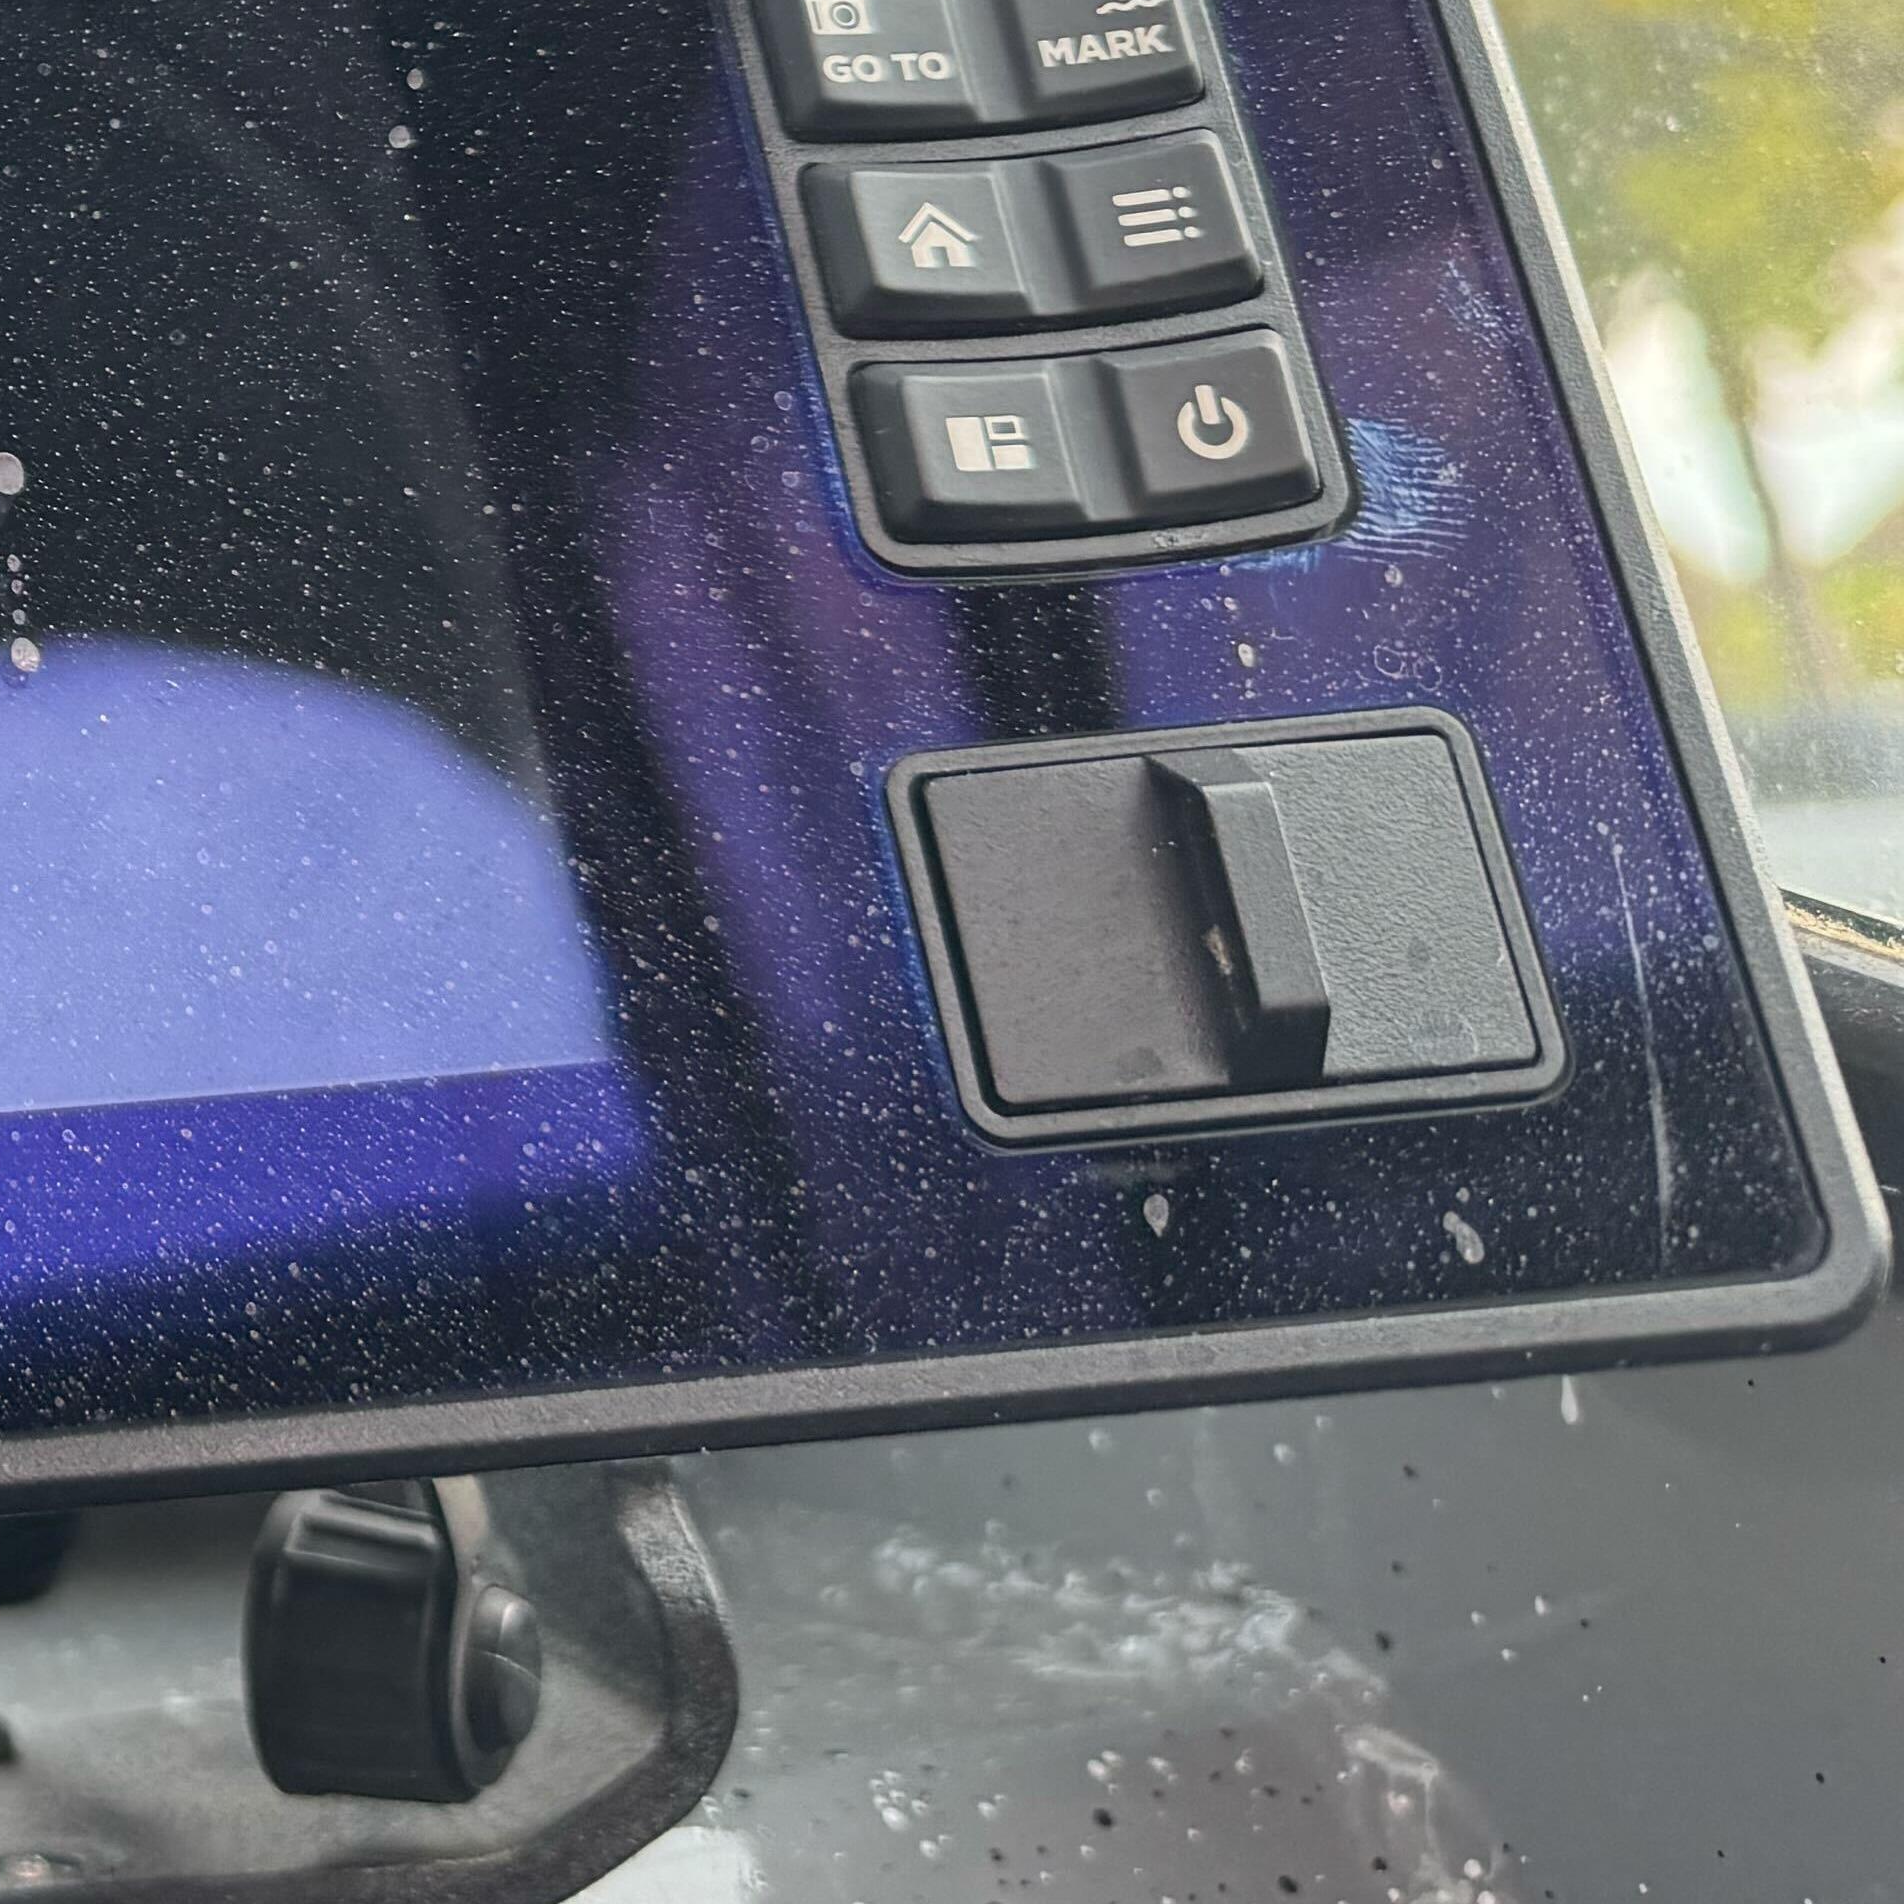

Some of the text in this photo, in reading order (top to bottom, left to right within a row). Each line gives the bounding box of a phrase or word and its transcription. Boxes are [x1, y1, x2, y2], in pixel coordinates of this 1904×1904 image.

[1037, 24, 1176, 68] MARK
[822, 51, 952, 83] GO TO
